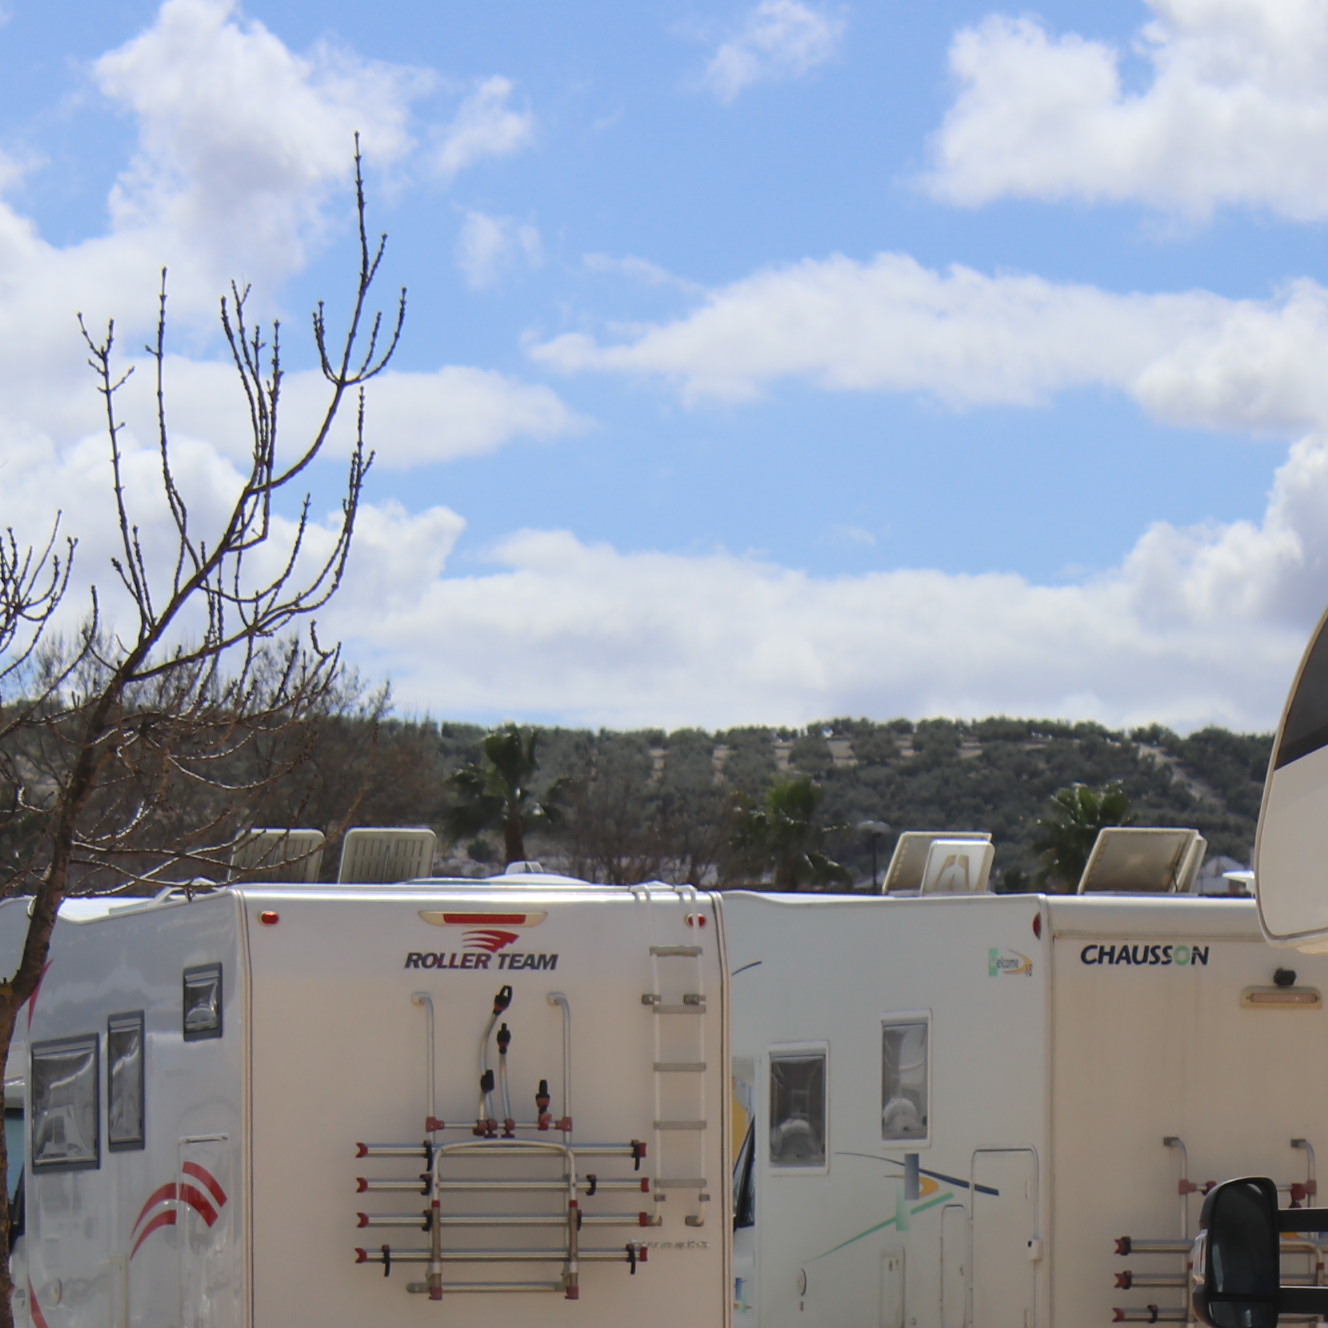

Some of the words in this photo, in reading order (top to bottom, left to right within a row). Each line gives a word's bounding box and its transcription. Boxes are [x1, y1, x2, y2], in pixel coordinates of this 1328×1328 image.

[404, 952, 492, 969] ROLLER
[498, 953, 559, 970] TEAM
[1080, 944, 1210, 966] CHAUSSON
